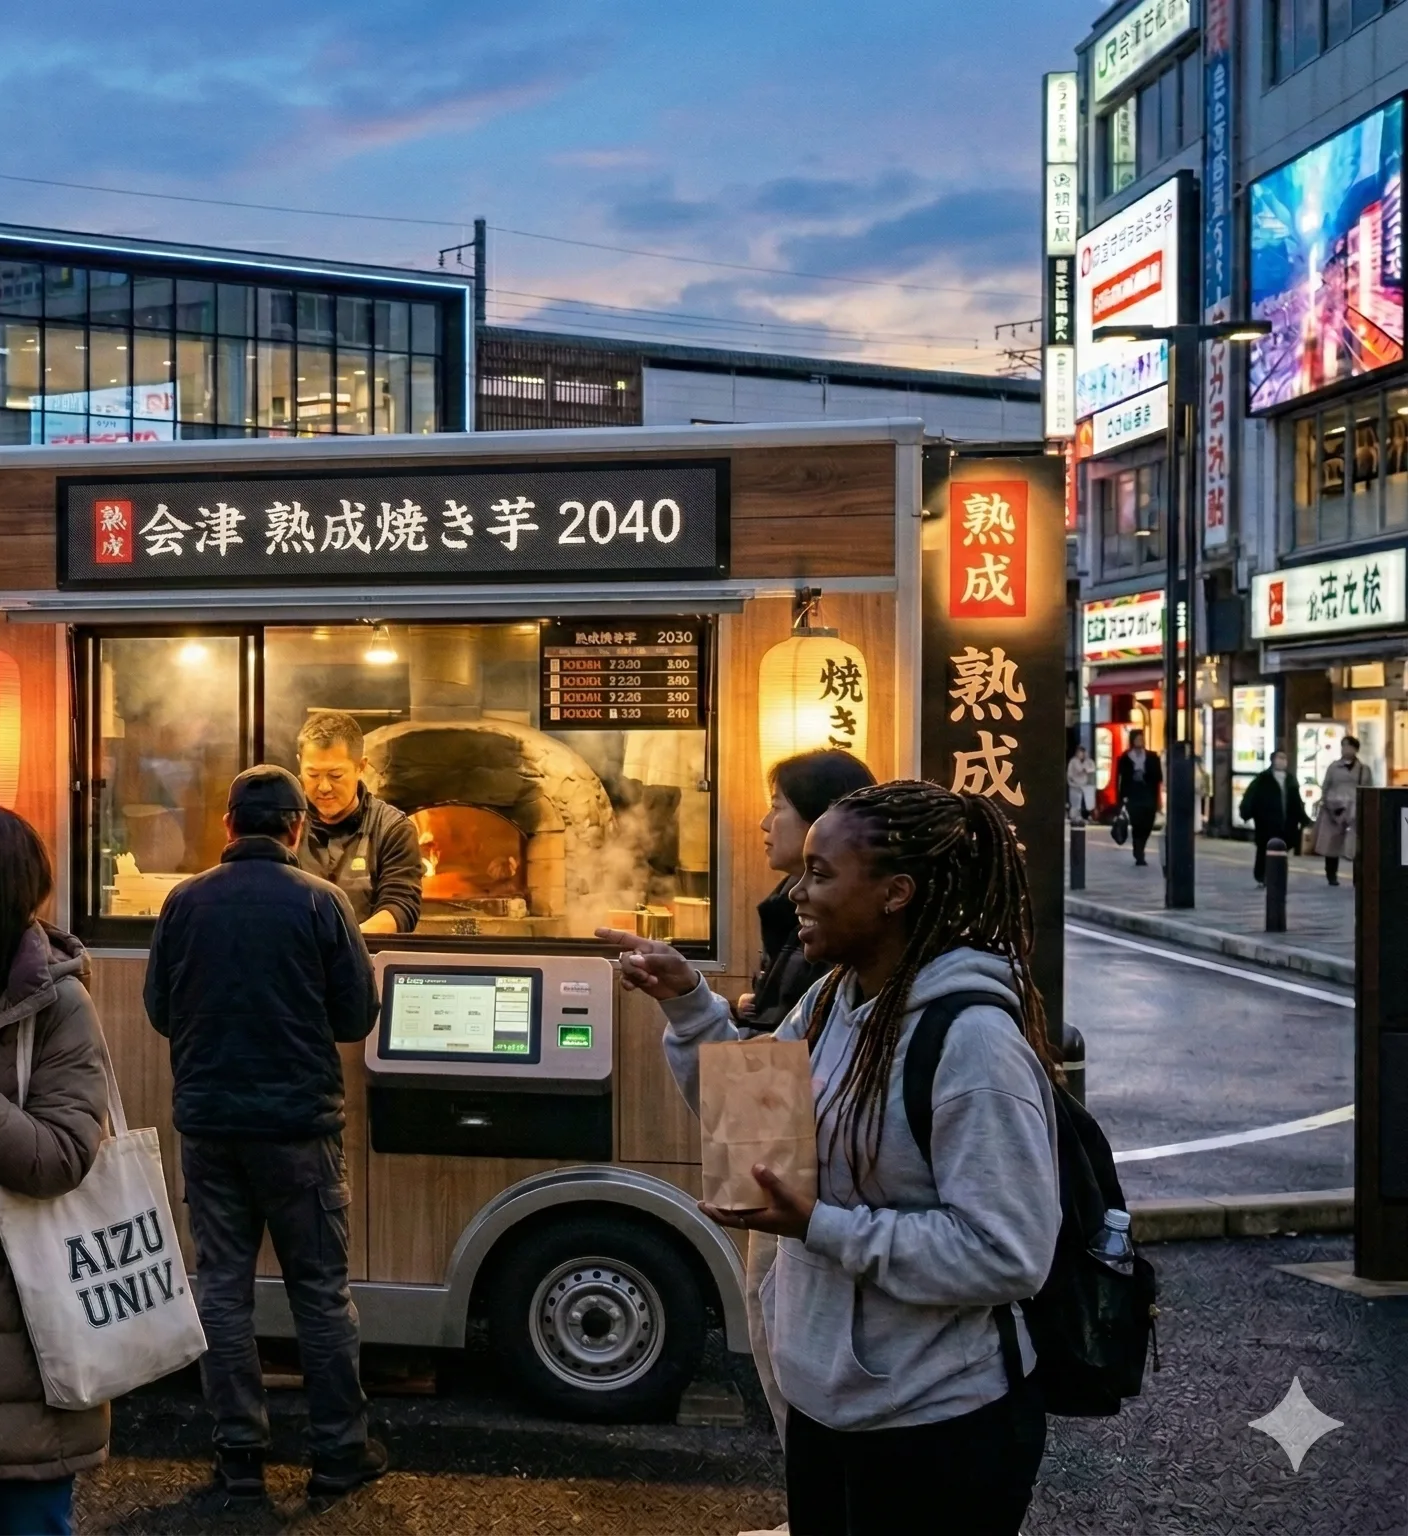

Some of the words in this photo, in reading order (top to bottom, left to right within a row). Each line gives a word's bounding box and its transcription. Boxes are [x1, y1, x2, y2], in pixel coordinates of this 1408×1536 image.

[1098, 37, 1117, 79] JR
[137, 501, 246, 557] 会津
[264, 498, 541, 556] 熟成焼き芋
[557, 498, 681, 546] 2040
[959, 492, 1016, 607] 熟成
[657, 631, 693, 644] 2030
[948, 646, 1027, 807] 熟成
[64, 1207, 166, 1283] AIZU
[75, 1258, 185, 1329] UNIV.
